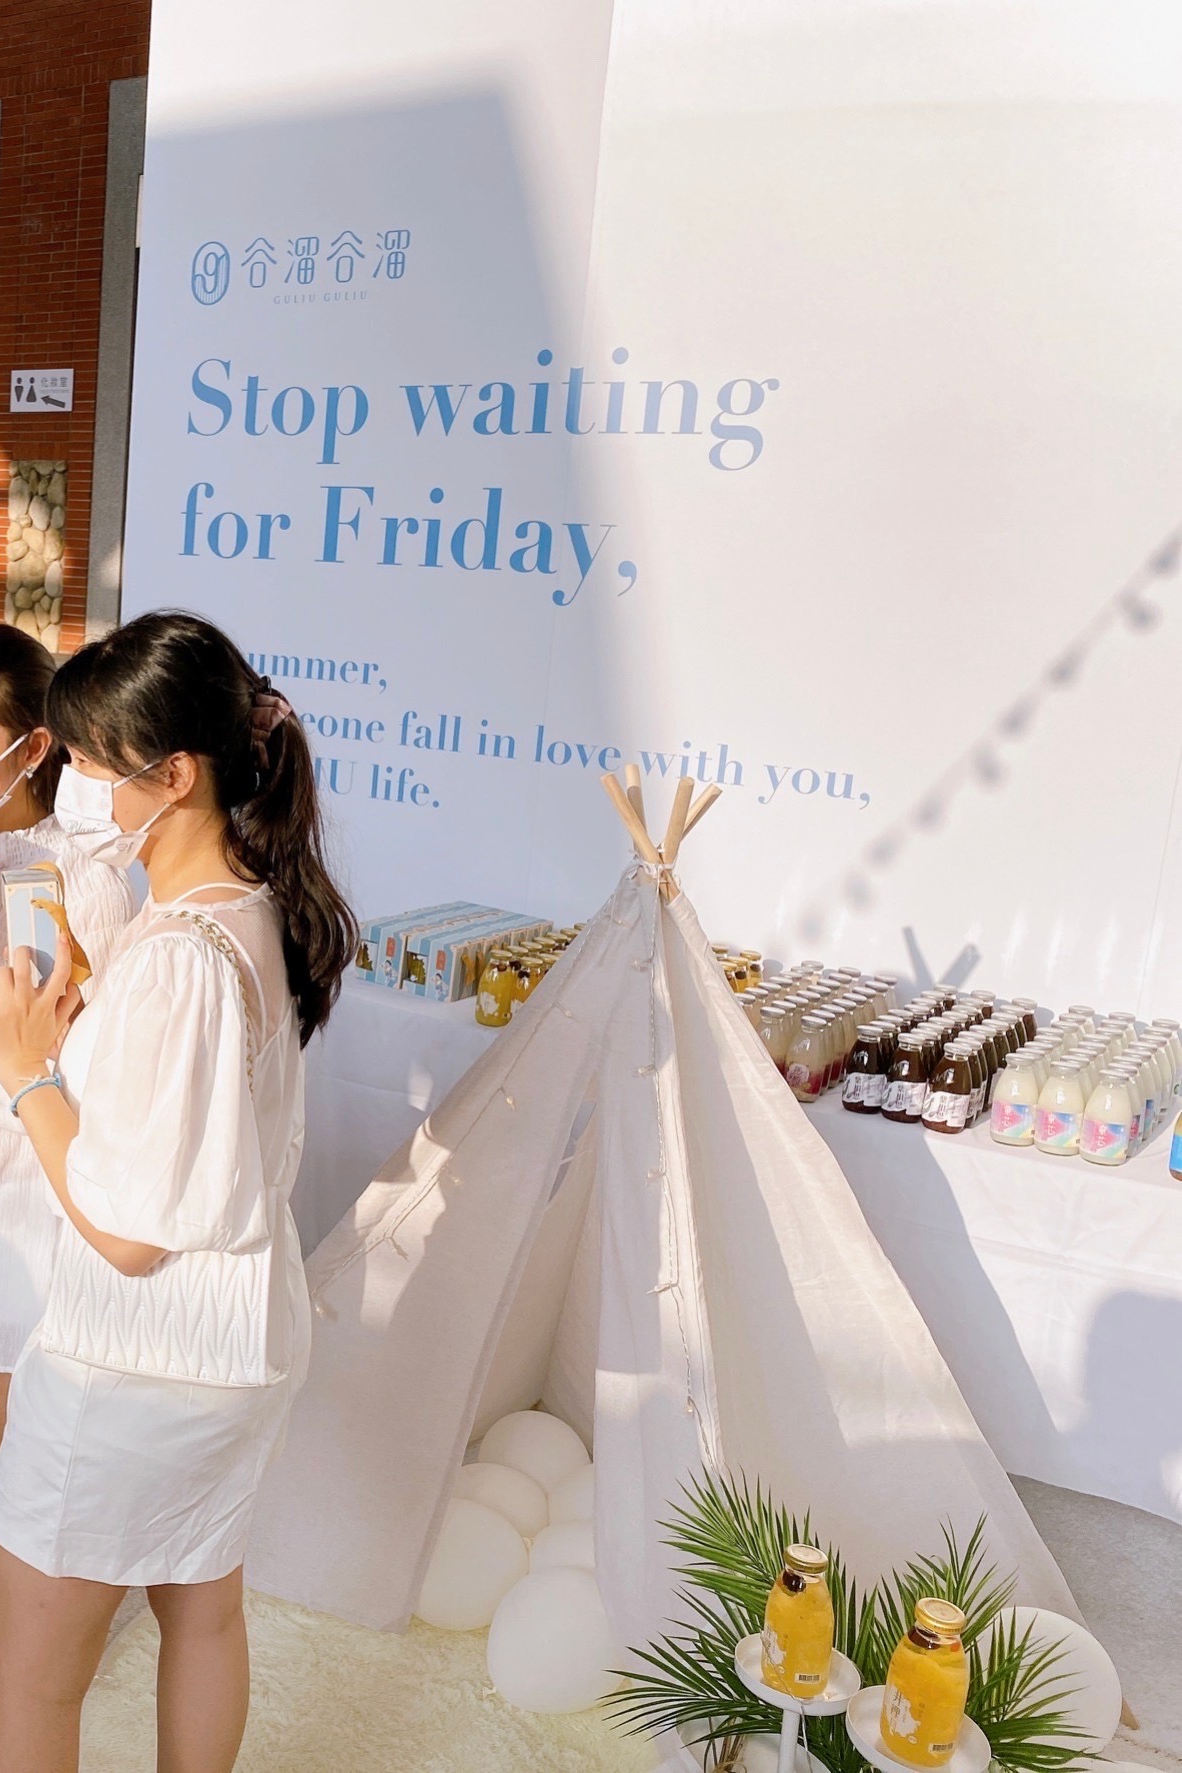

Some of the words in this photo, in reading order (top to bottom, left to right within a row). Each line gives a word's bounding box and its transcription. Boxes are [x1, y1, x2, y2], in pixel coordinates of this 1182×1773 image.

[240, 229, 412, 289] 谷溜谷溜
[273, 293, 316, 305] GULIU
[323, 290, 367, 303] GULIU
[186, 357, 370, 466] Stop
[398, 348, 781, 472] waiting
[177, 481, 292, 561] for
[314, 485, 639, 608] Friday,
[246, 652, 387, 694] ummer,
[298, 711, 386, 744] eone
[398, 710, 462, 753] fall
[477, 719, 516, 759] in
[533, 724, 622, 772] love
[637, 740, 745, 787] with
[757, 763, 871, 811] you,
[369, 763, 440, 808] life.
